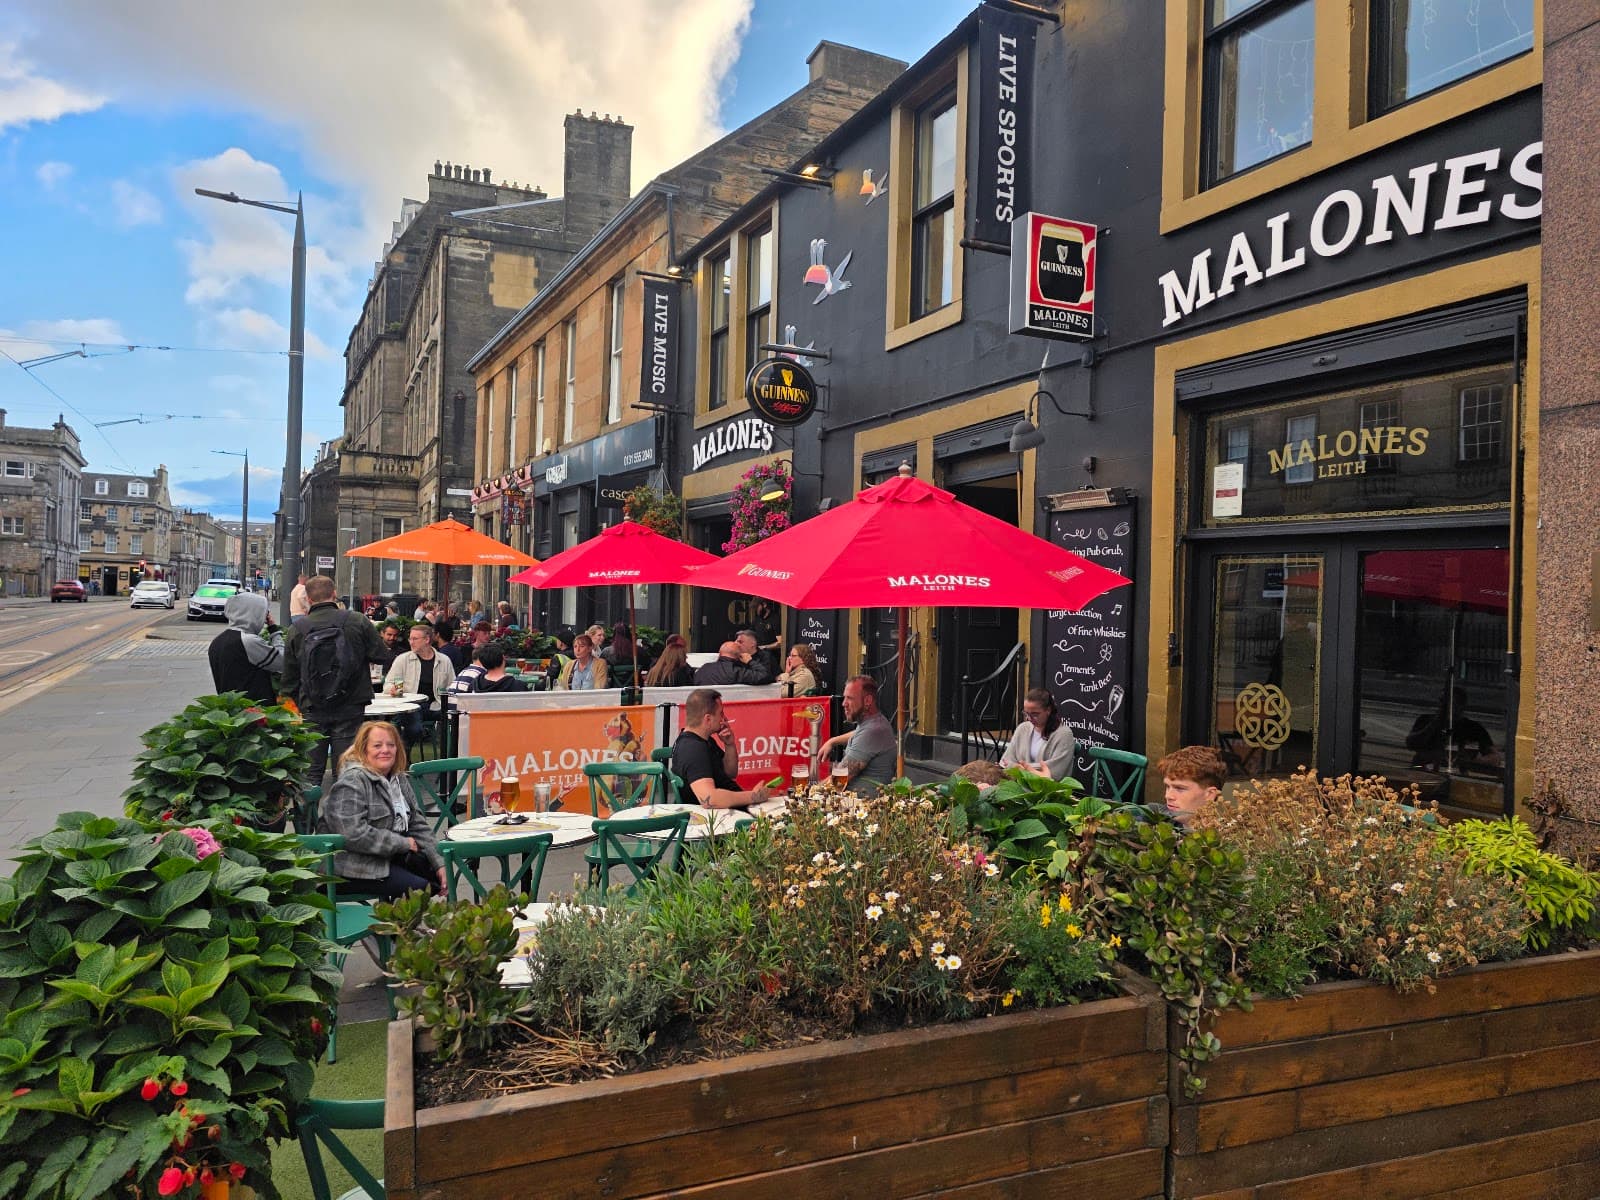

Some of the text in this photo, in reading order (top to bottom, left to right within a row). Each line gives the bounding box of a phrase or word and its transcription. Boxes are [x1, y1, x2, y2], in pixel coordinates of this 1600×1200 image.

[995, 33, 1017, 223] LIVE SPORTS
[1158, 140, 1543, 328] MALONES
[1040, 260, 1083, 277] GUINNESS
[1033, 309, 1089, 329] MALONES
[1052, 321, 1070, 330] LEITH
[652, 293, 669, 394] LIVE MUSIC
[761, 384, 810, 405] GUINNESS
[692, 418, 775, 471] MALONES
[1267, 426, 1430, 475] MALONES
[1318, 460, 1367, 479] LEITH
[887, 574, 991, 588] MALONES
[738, 736, 810, 758] LONES
[539, 773, 584, 785] LEITH
